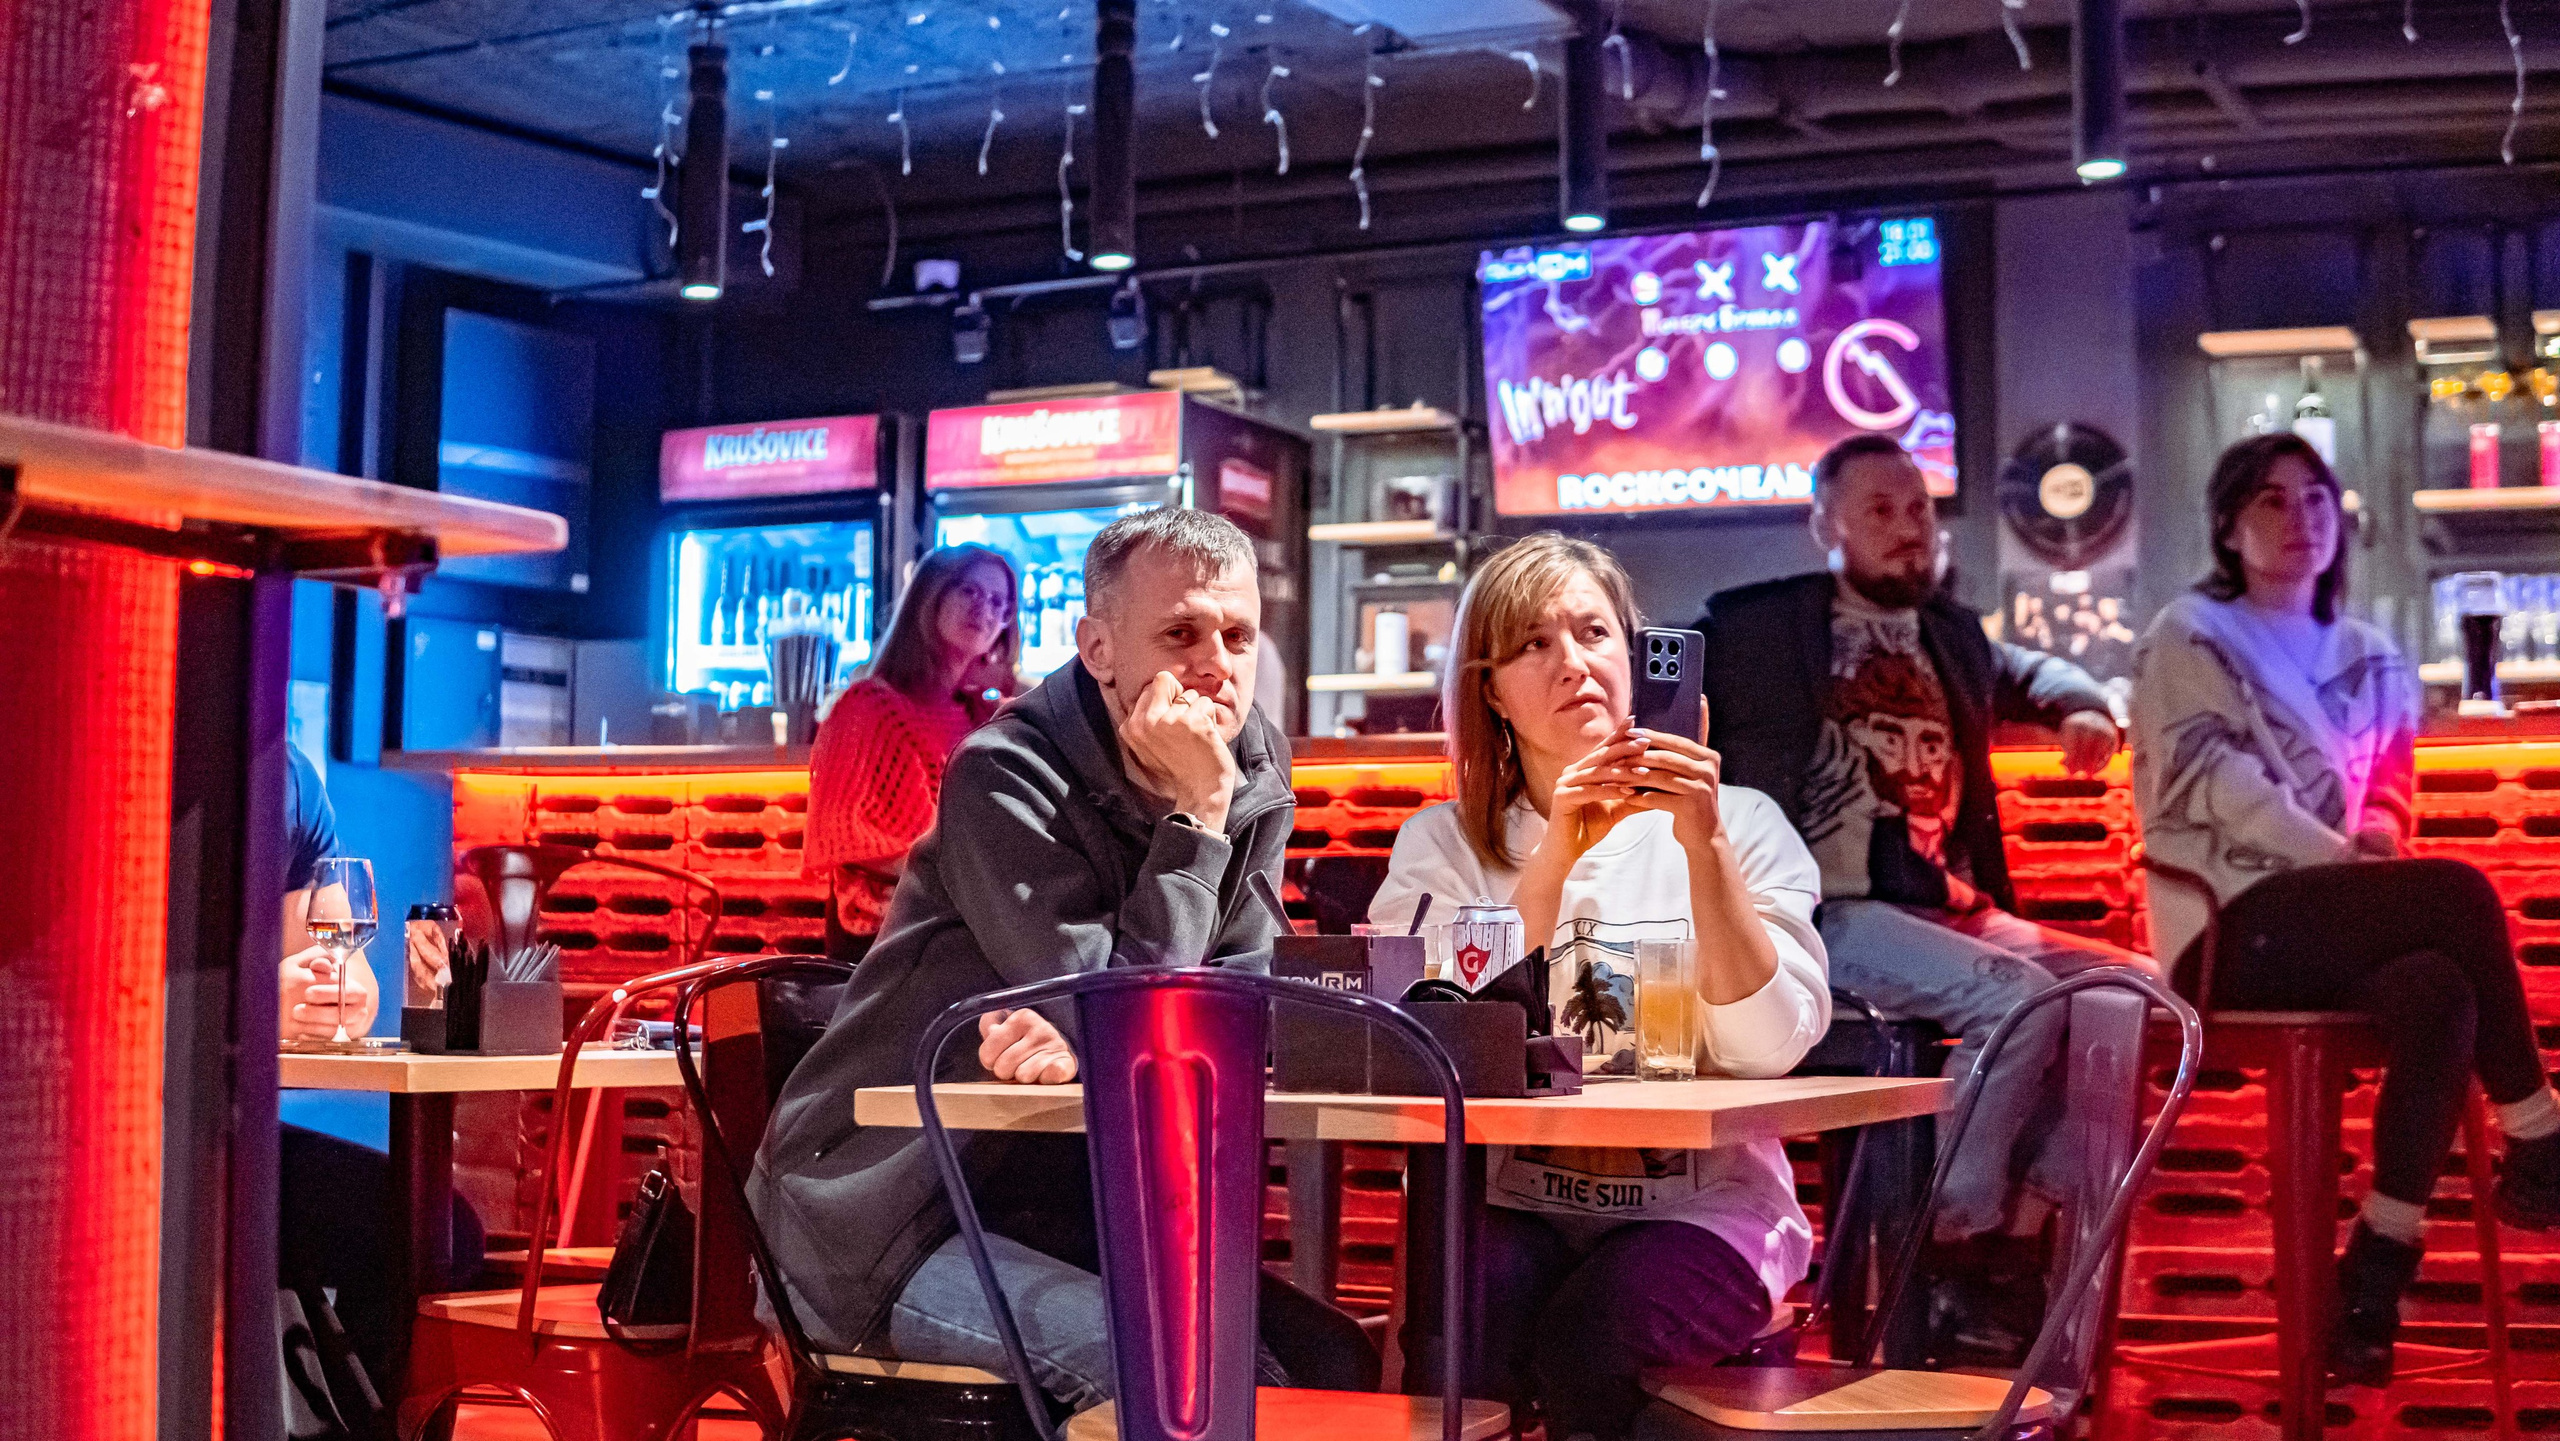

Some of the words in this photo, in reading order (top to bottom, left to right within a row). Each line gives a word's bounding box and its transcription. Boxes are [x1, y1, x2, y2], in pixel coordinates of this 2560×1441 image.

[704, 427, 829, 471] KRUŠOVICE
[1573, 920, 1598, 937] XIX
[1463, 951, 1479, 974] G
[1543, 1171, 1591, 1204] THE
[1596, 1183, 1644, 1207] SUN
